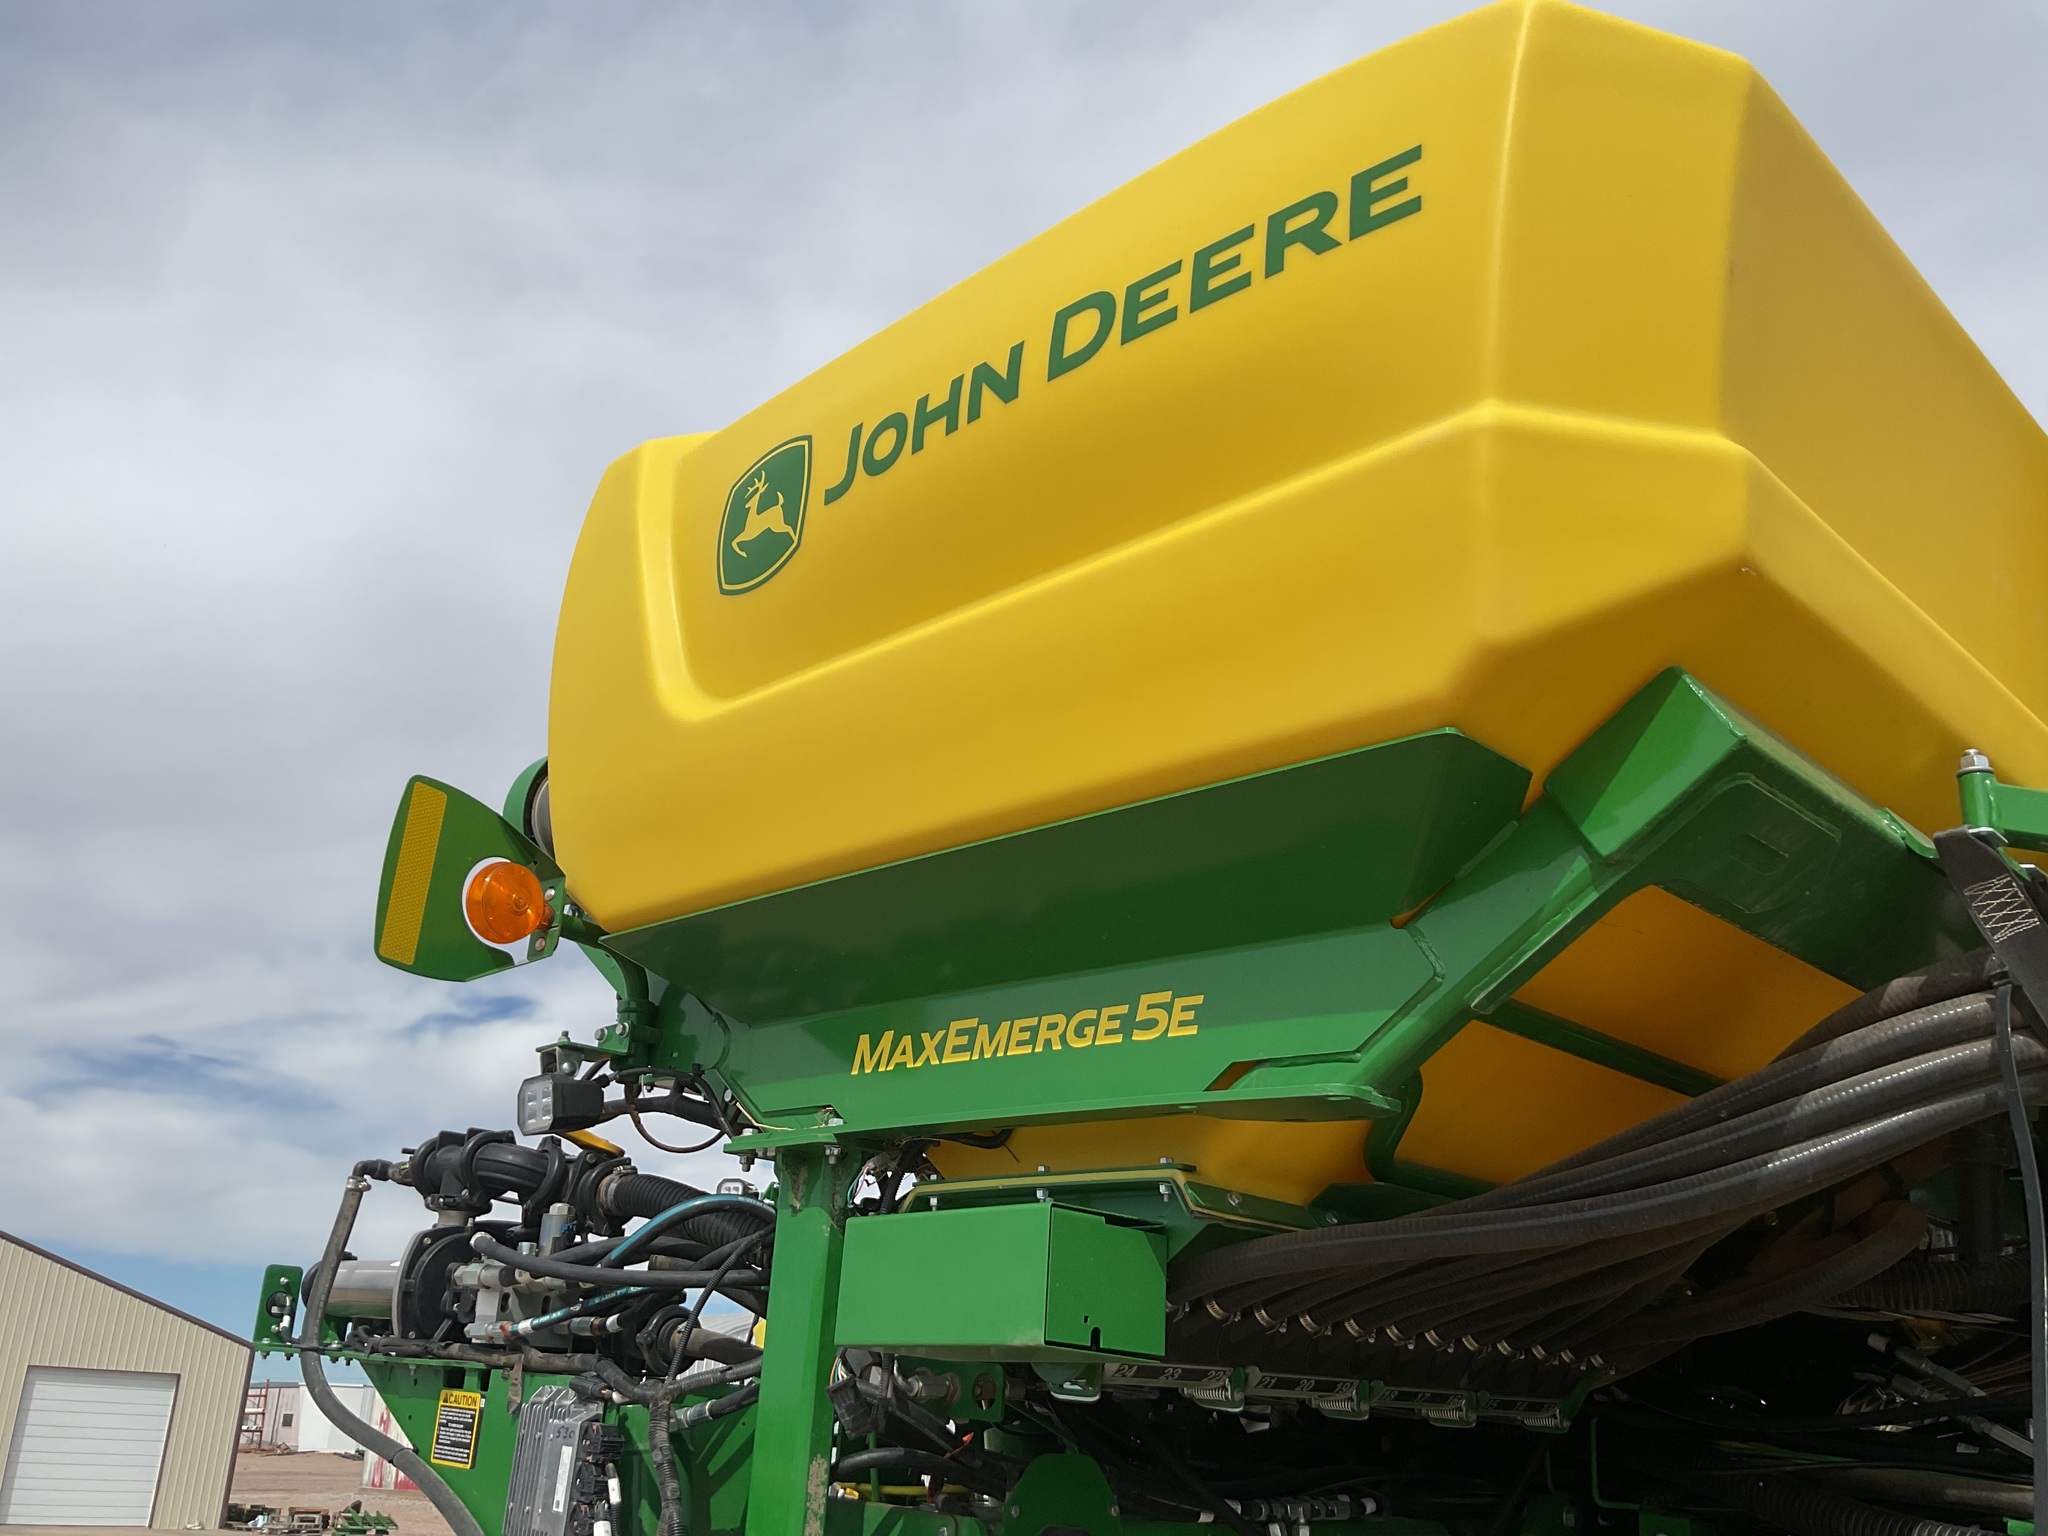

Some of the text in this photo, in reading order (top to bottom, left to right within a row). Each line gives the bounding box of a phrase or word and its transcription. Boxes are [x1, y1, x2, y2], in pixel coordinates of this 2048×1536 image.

[824, 144, 1422, 506] JOHN DEERE
[1131, 990, 1204, 1041] 5E
[1114, 1364, 1224, 1382] 24 23 22
[1258, 1376, 1351, 1393] 21 20 19
[448, 1393, 477, 1407] CAUTION
[1415, 1392, 1431, 1402] 17
